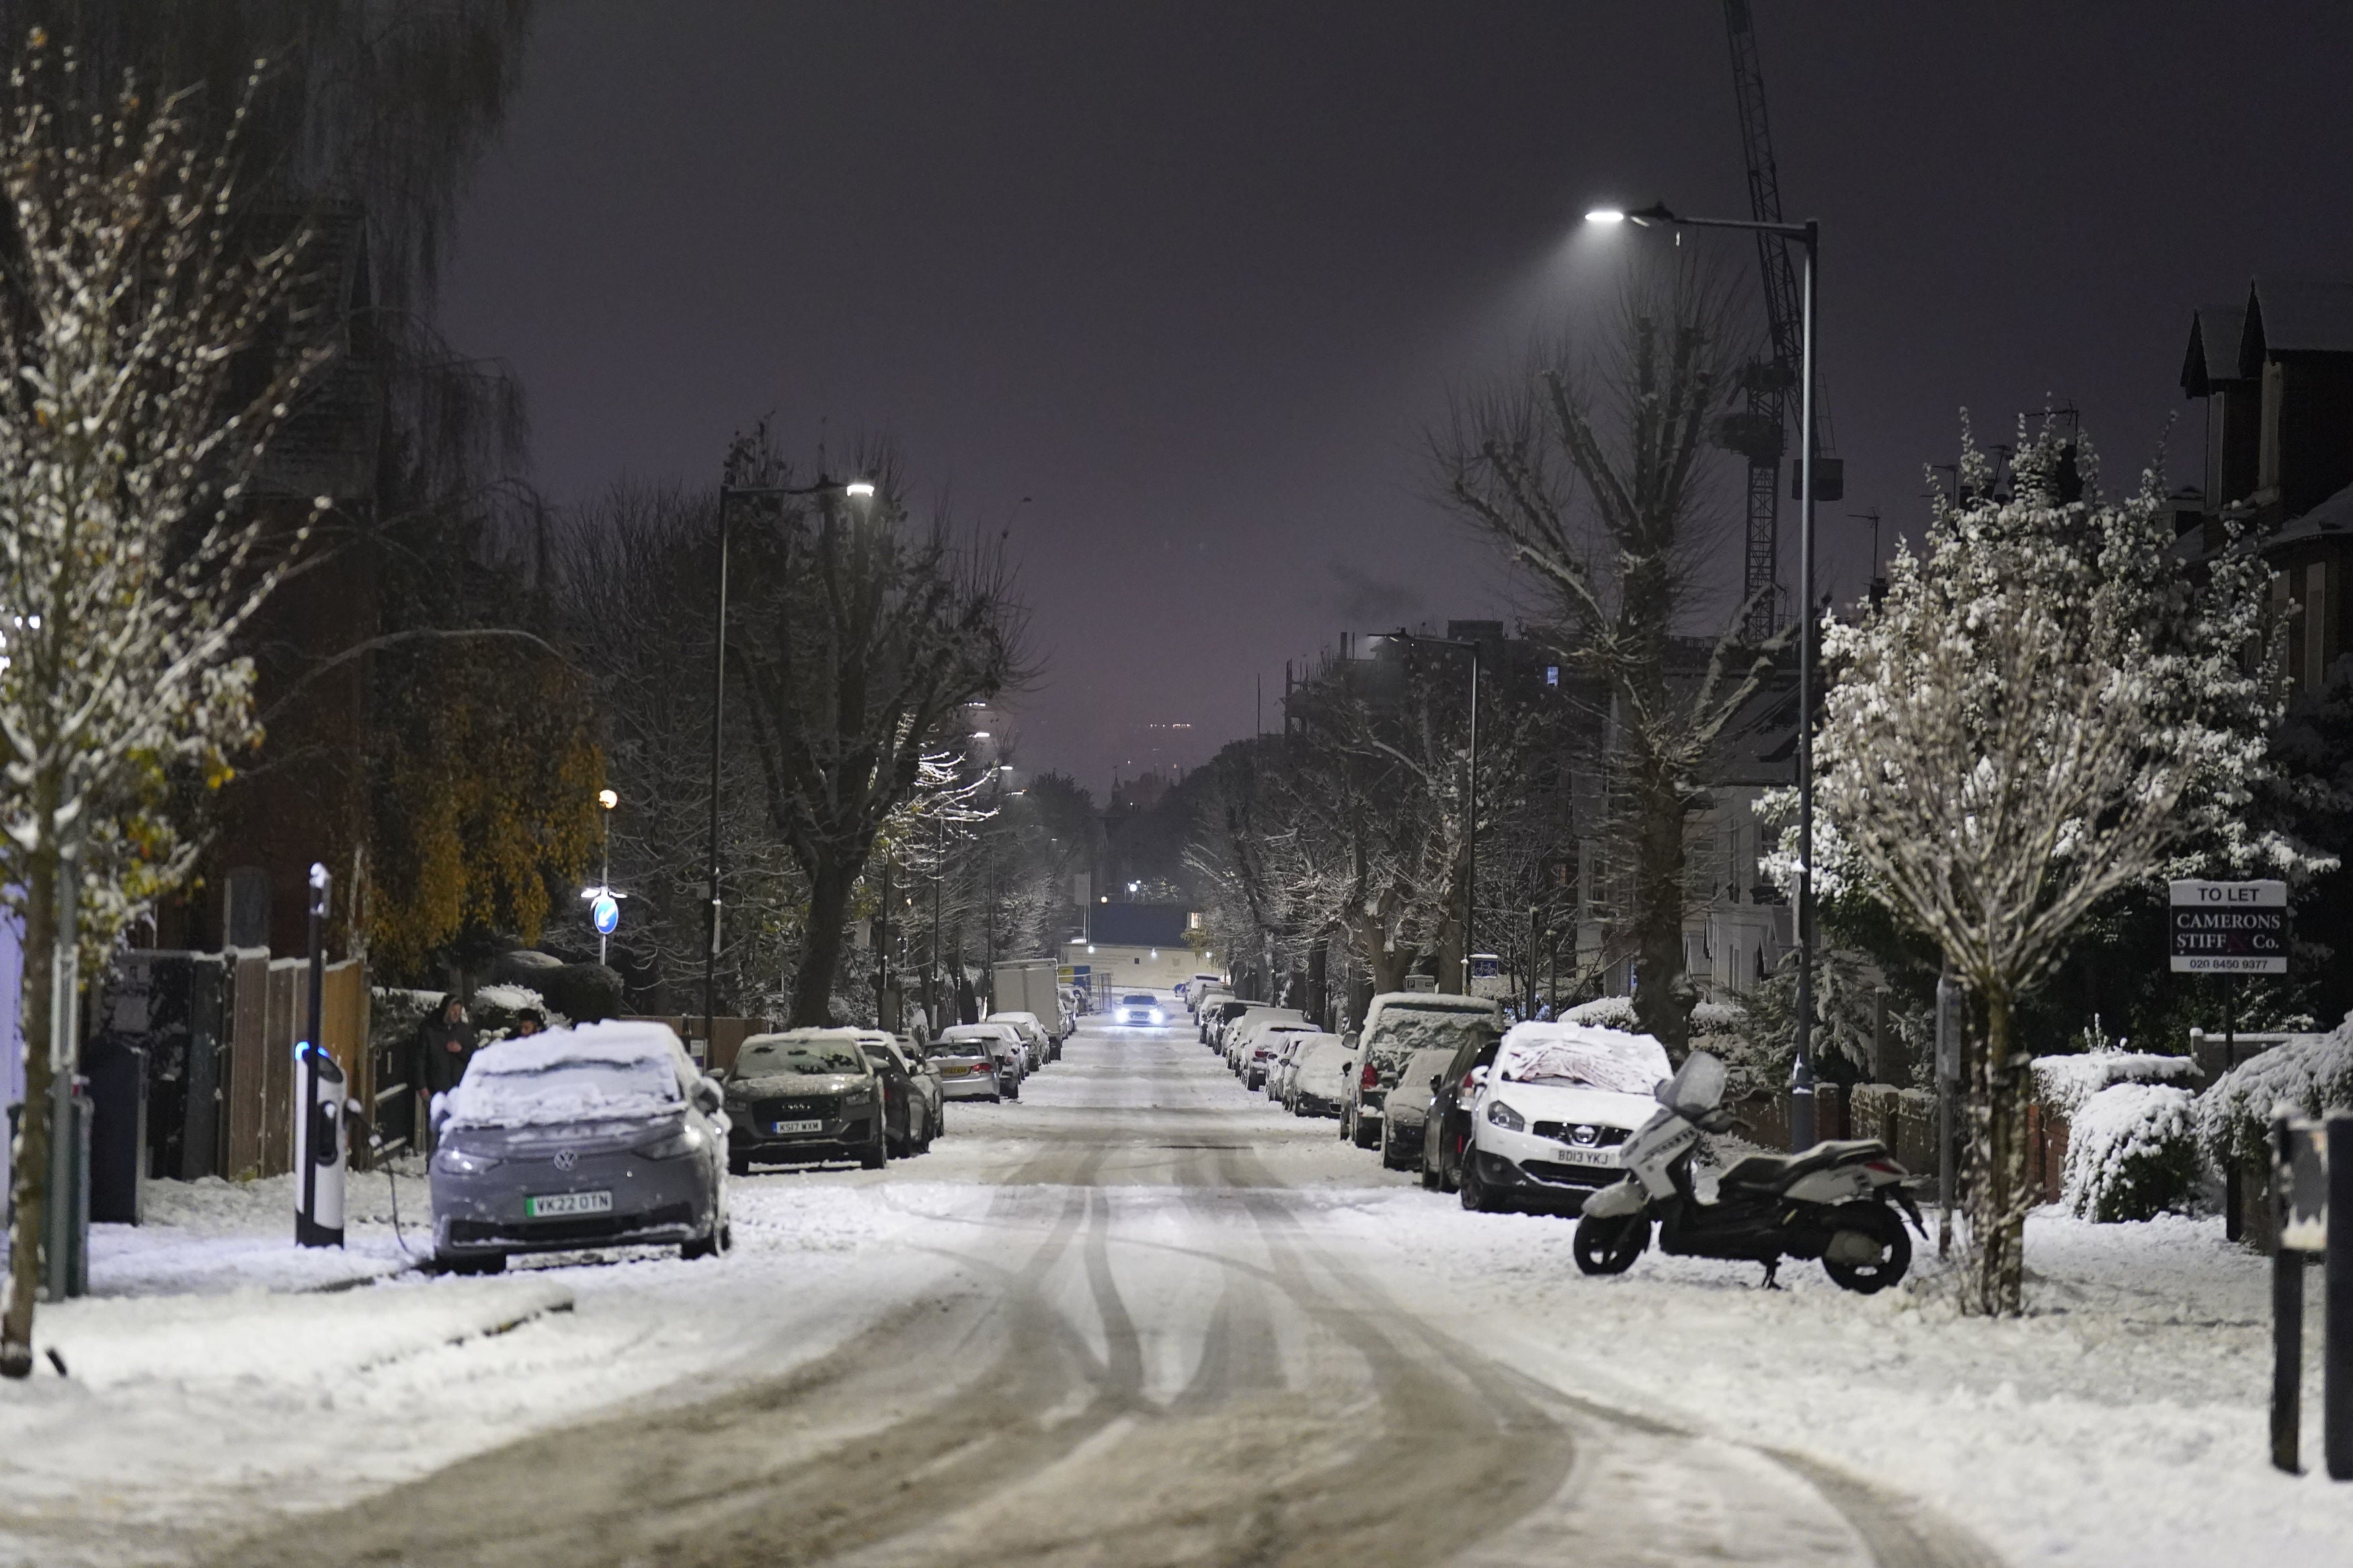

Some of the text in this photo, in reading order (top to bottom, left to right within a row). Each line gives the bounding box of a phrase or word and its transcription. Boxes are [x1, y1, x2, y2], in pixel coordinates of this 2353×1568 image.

[2198, 887, 2260, 902] TO LET
[2177, 913, 2281, 929] CAMERONS
[2177, 934, 2227, 948] STIFF
[2190, 960, 2210, 969] 020
[1558, 1151, 1609, 1165] BD13 YKJ
